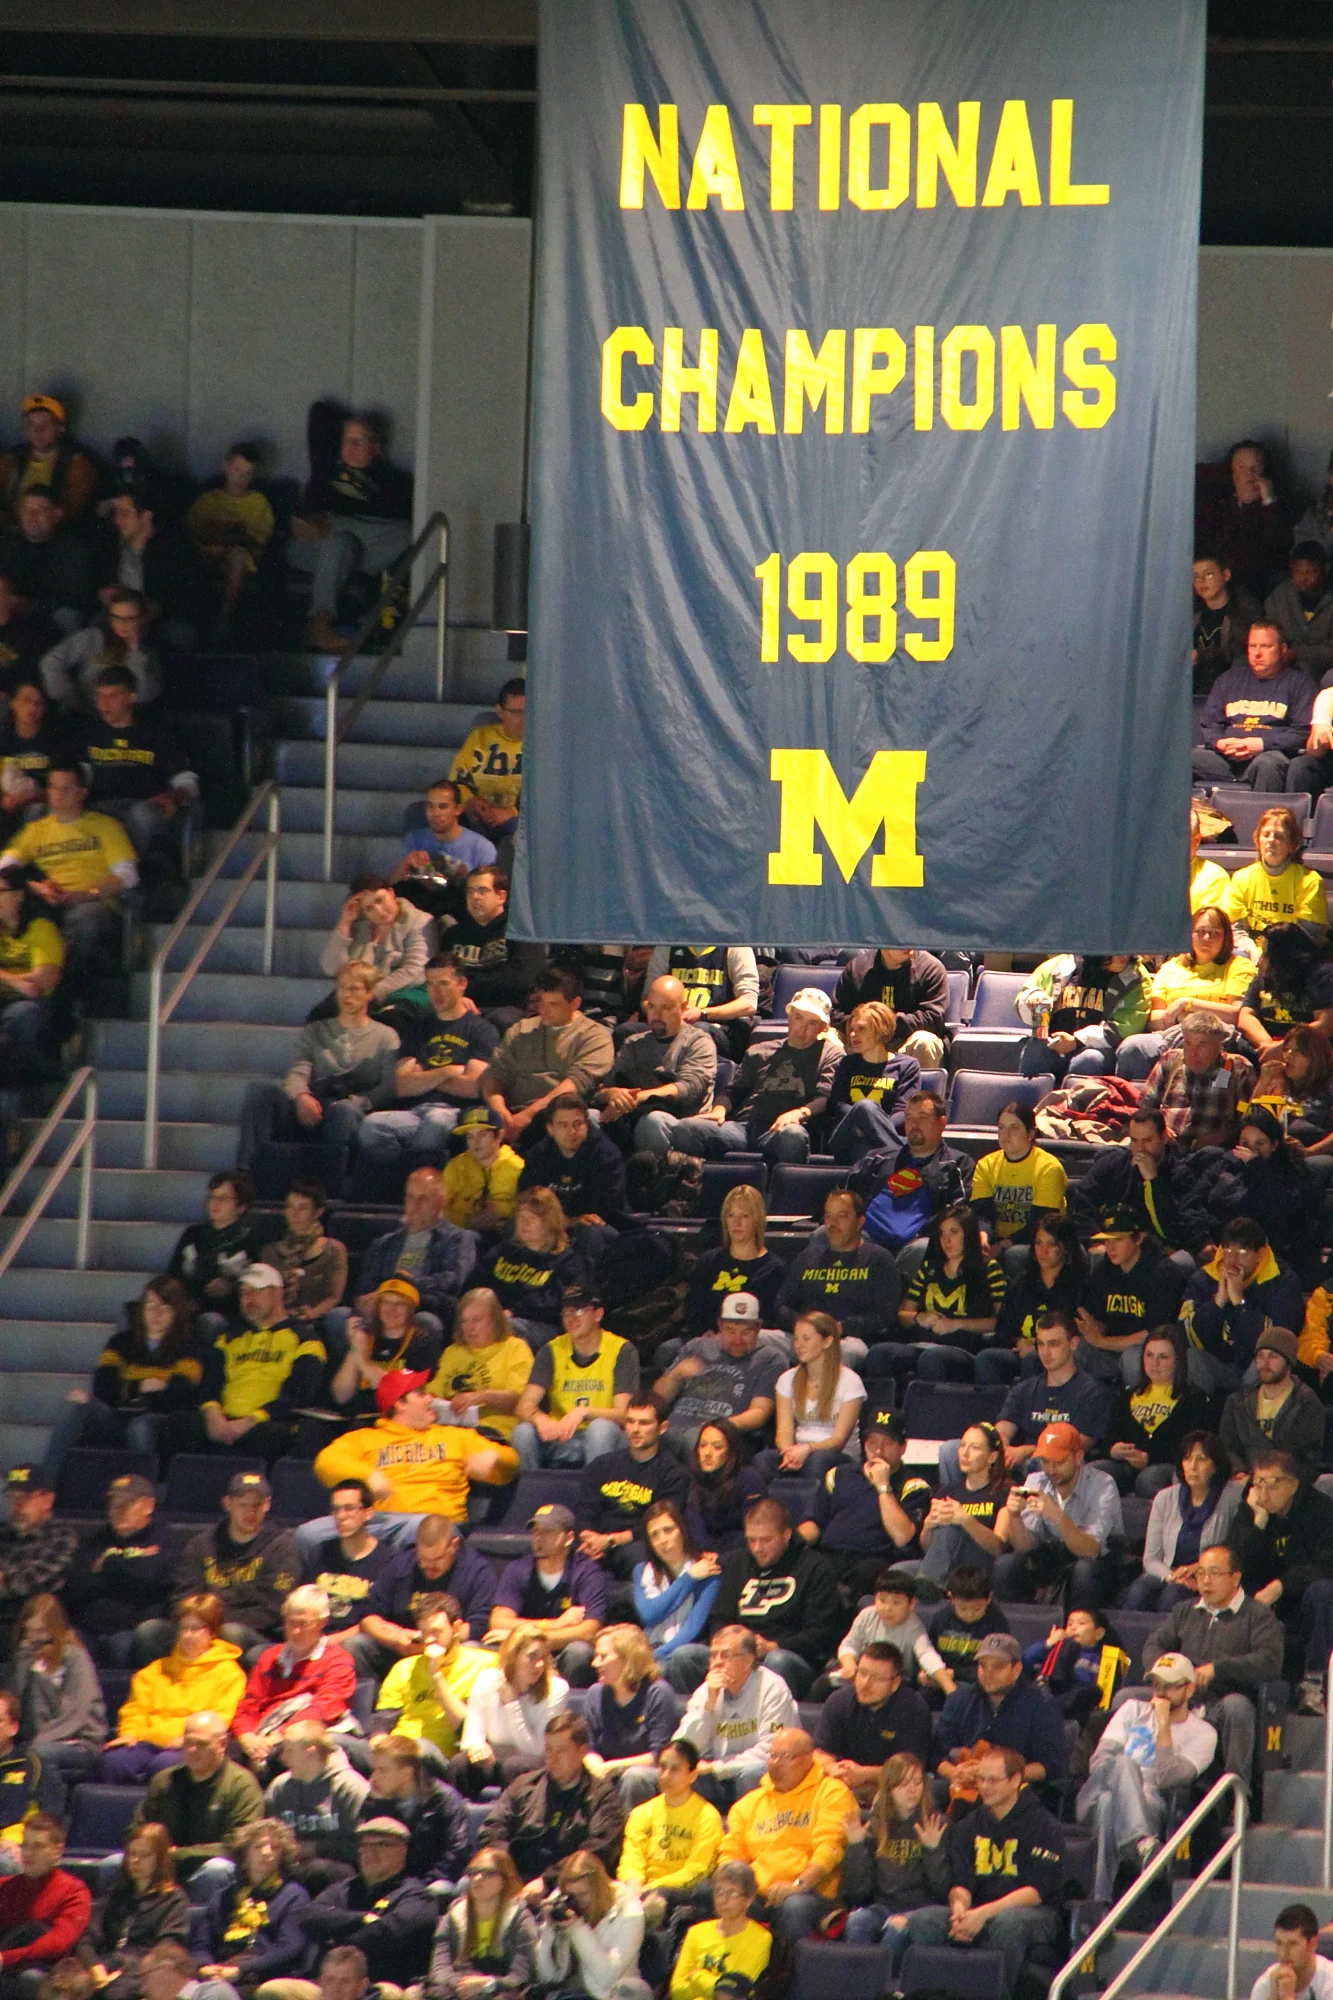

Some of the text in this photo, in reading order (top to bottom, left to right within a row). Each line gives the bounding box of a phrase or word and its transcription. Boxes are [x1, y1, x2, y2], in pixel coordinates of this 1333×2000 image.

[619, 99, 1110, 212] NATIONAL
[600, 324, 1117, 435] CHAMPIONS
[754, 550, 956, 663] 1989
[768, 749, 927, 887] M
[1254, 900, 1295, 914] THIS IS
[994, 1186, 1033, 1202] MAIZE
[712, 1271, 749, 1292] M
[802, 1267, 869, 1282] MICHIGAN
[825, 1283, 840, 1294] M
[925, 1283, 968, 1317] M
[876, 1411, 891, 1425] M
[1267, 1727, 1282, 1752] M
[974, 1835, 1019, 1876] M
